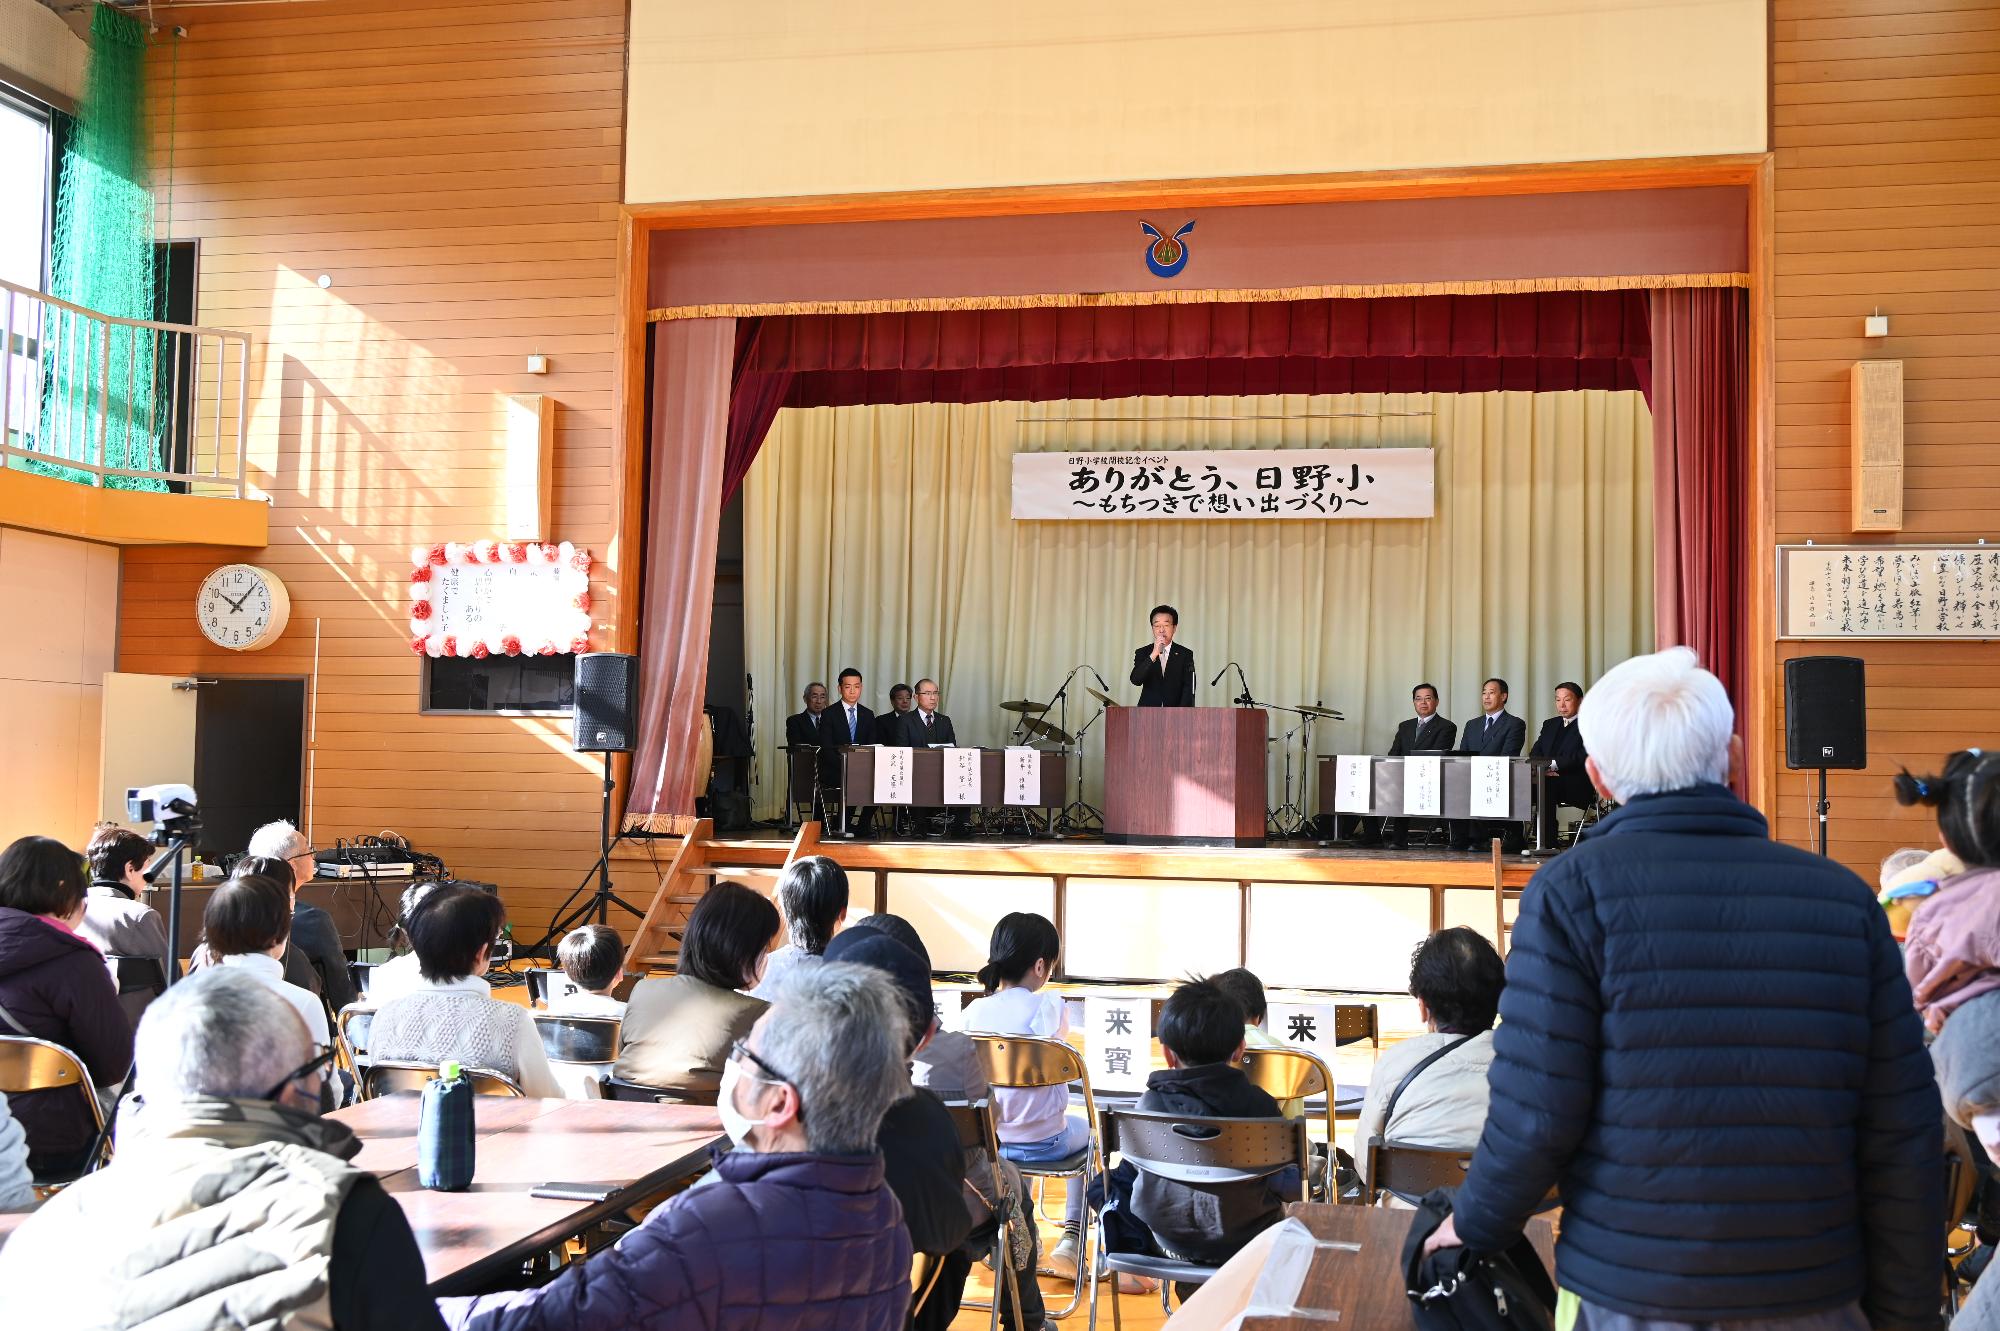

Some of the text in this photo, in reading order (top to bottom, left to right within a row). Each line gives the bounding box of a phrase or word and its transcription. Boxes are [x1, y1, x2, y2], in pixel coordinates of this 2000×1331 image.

[1069, 464, 1375, 492] ありがとう、日野小
[222, 577, 229, 588] 11
[234, 573, 243, 584] 12
[211, 588, 220, 599] 10
[258, 586, 264, 597] 2
[208, 602, 215, 612] 9
[260, 602, 267, 612] 3
[211, 617, 218, 627] 8
[255, 617, 262, 626] 4
[222, 627, 228, 637] 7
[233, 630, 239, 641] 6
[246, 627, 252, 637] 5
[1287, 1013, 1317, 1042] 来
[1105, 1007, 1132, 1075] 来賓
